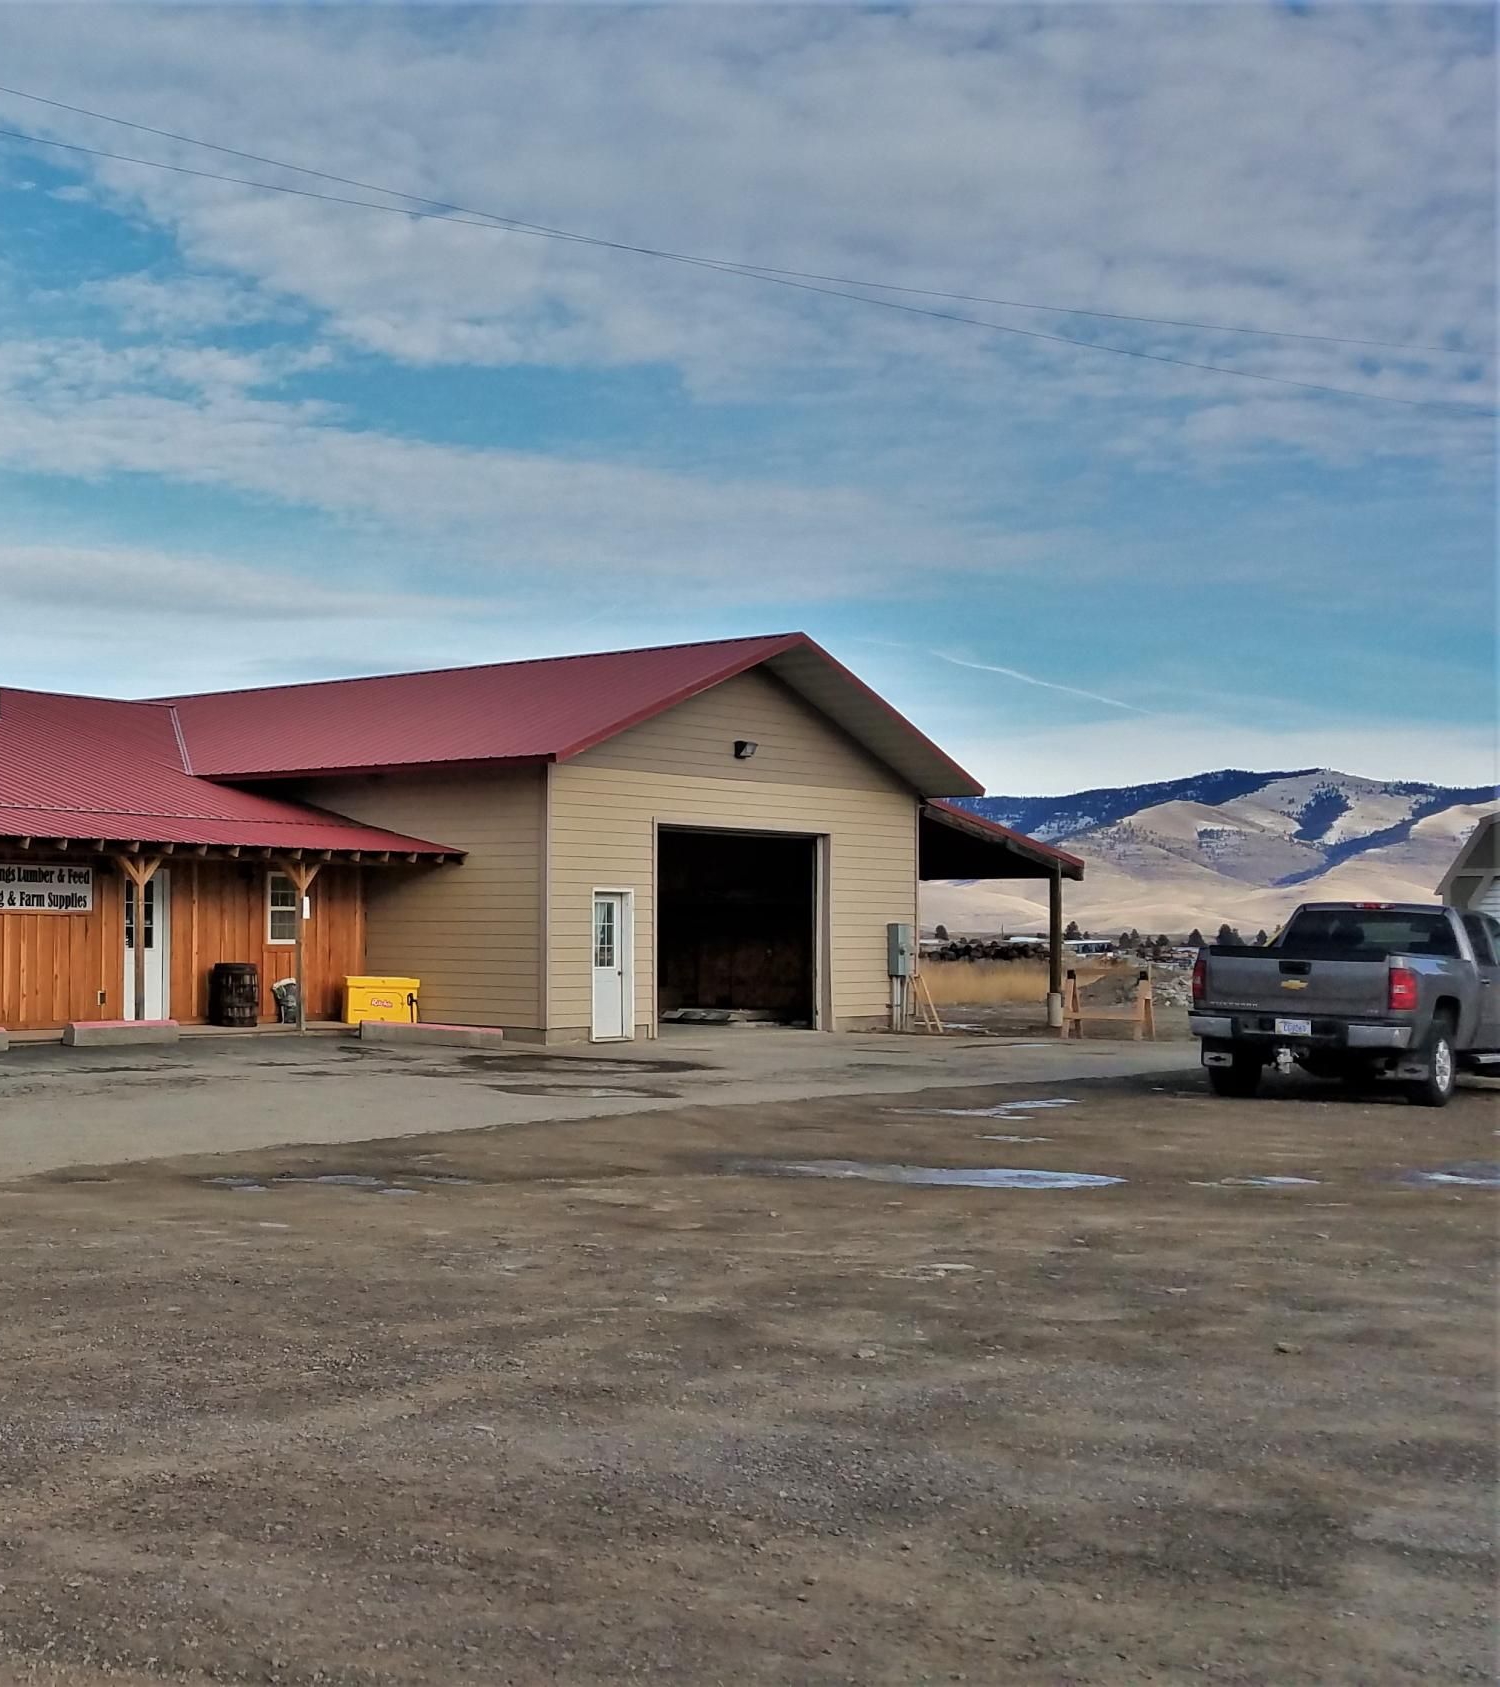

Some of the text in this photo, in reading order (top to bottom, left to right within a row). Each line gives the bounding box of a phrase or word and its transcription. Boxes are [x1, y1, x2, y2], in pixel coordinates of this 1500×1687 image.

[17, 867, 55, 883] Lumber
[57, 869, 66, 883] &
[67, 868, 90, 885] Feed
[8, 890, 17, 906] &
[19, 891, 45, 907] Farm
[47, 893, 87, 909] Supplies
